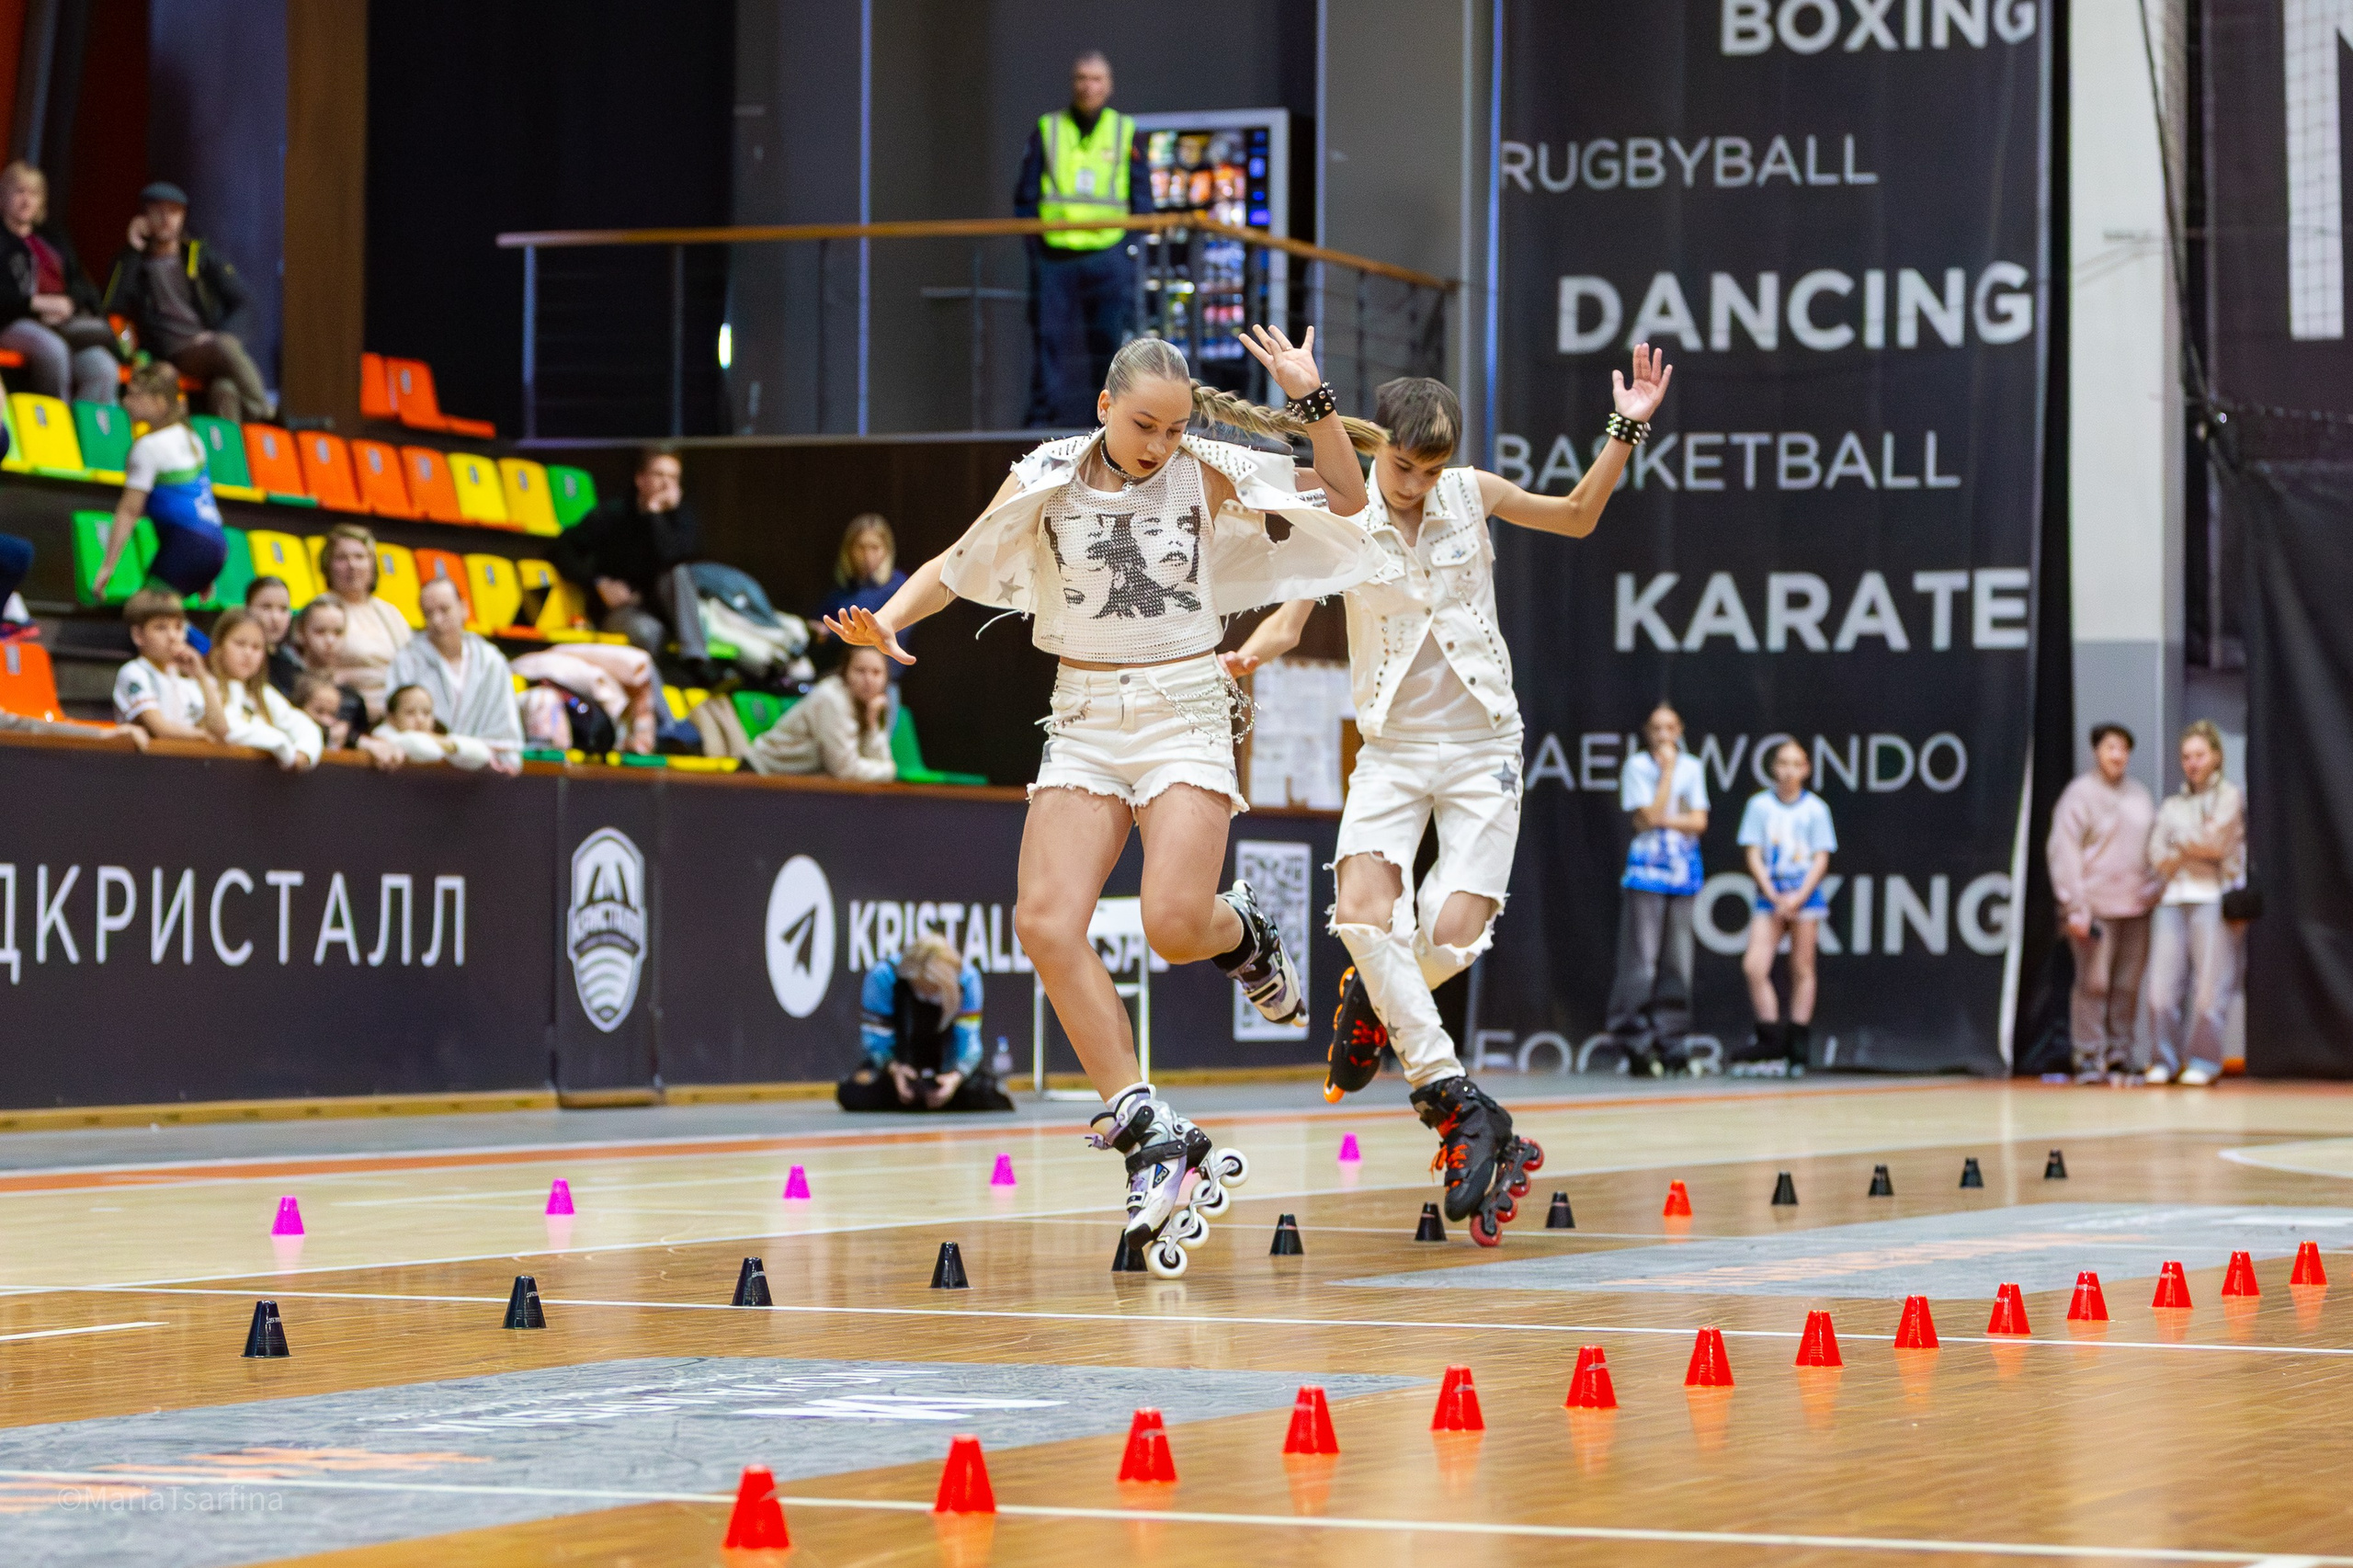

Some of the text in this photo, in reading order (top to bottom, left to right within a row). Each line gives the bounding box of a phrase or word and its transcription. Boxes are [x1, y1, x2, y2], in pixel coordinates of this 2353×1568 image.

[1721, 0, 2037, 56] BOXING
[1500, 133, 1879, 194] RUGBYBALL
[1557, 261, 2033, 354] DANCING
[1614, 567, 2030, 652] KARATE
[1523, 733, 1969, 793] AEWONDO
